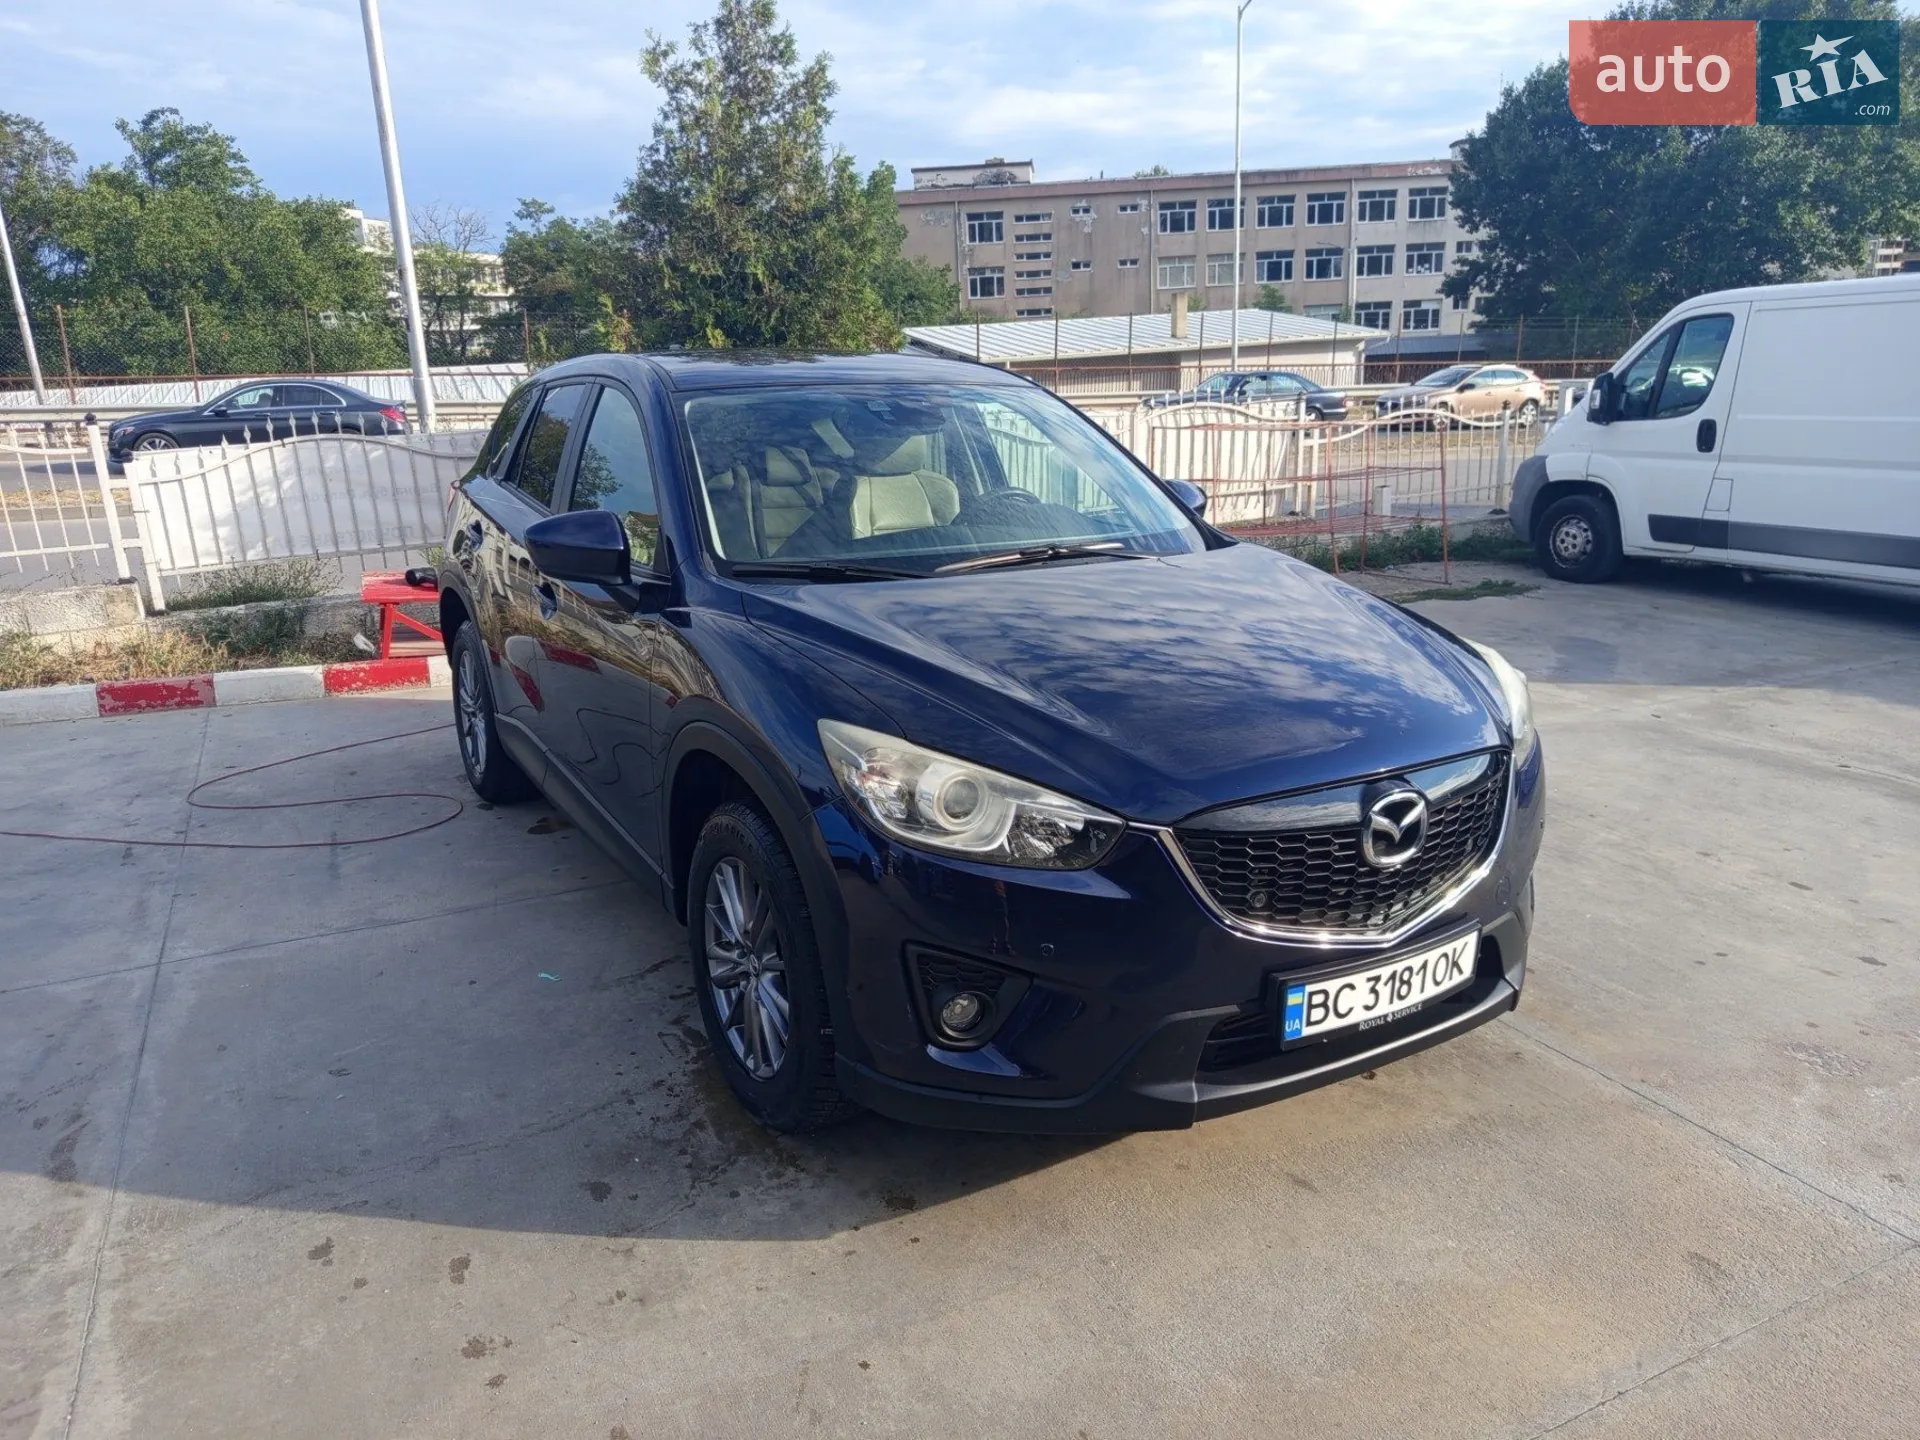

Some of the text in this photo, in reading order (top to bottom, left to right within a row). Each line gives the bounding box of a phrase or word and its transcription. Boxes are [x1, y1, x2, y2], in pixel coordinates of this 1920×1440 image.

[1306, 941, 1469, 1027] BC 3181 OK
[1285, 1018, 1301, 1032] UA
[1359, 1003, 1423, 1031] ROYAL SERVICE
